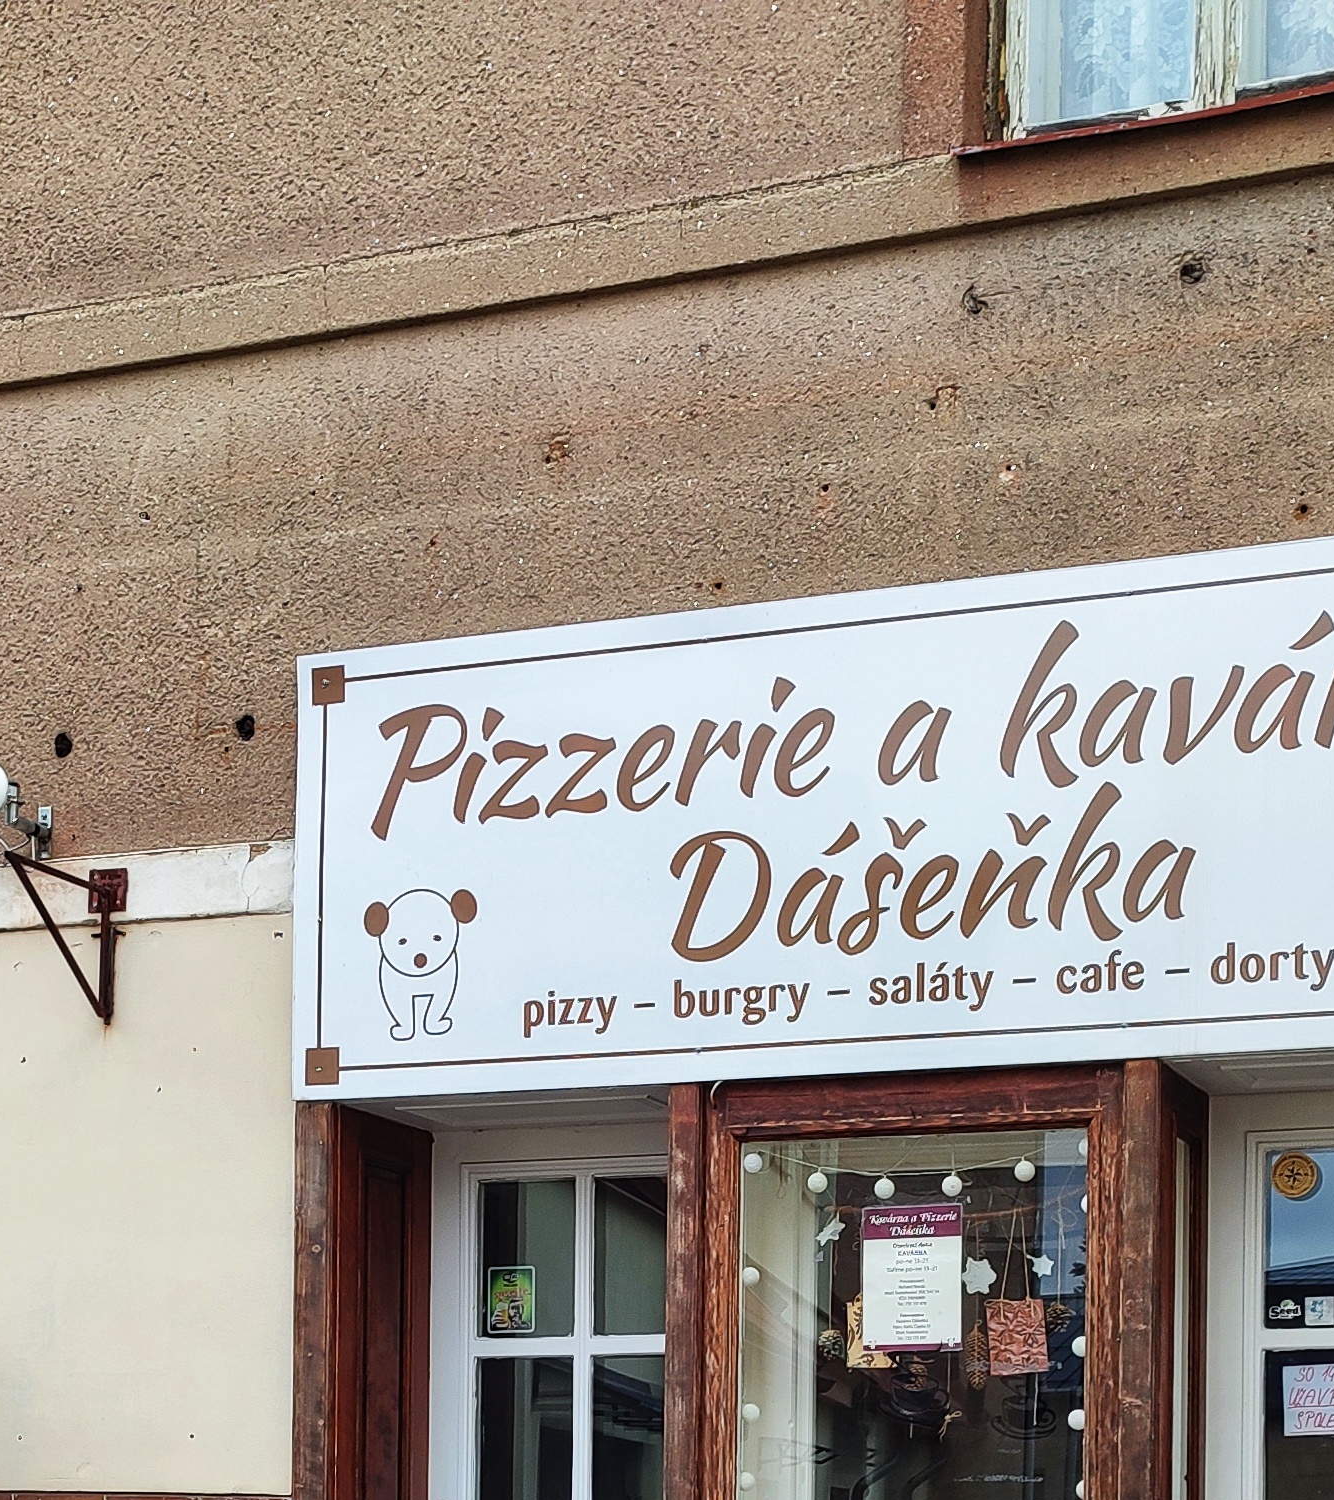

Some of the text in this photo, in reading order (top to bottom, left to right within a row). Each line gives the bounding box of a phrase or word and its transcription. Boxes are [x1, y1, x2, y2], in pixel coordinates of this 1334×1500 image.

[371, 677, 835, 841] Pizzerie
[878, 700, 952, 785] a
[670, 782, 1196, 963] Dášeňka
[524, 991, 617, 1038] pizzy
[674, 979, 810, 1025] burgry
[869, 962, 994, 1011] saláty
[1057, 949, 1144, 994] cafe
